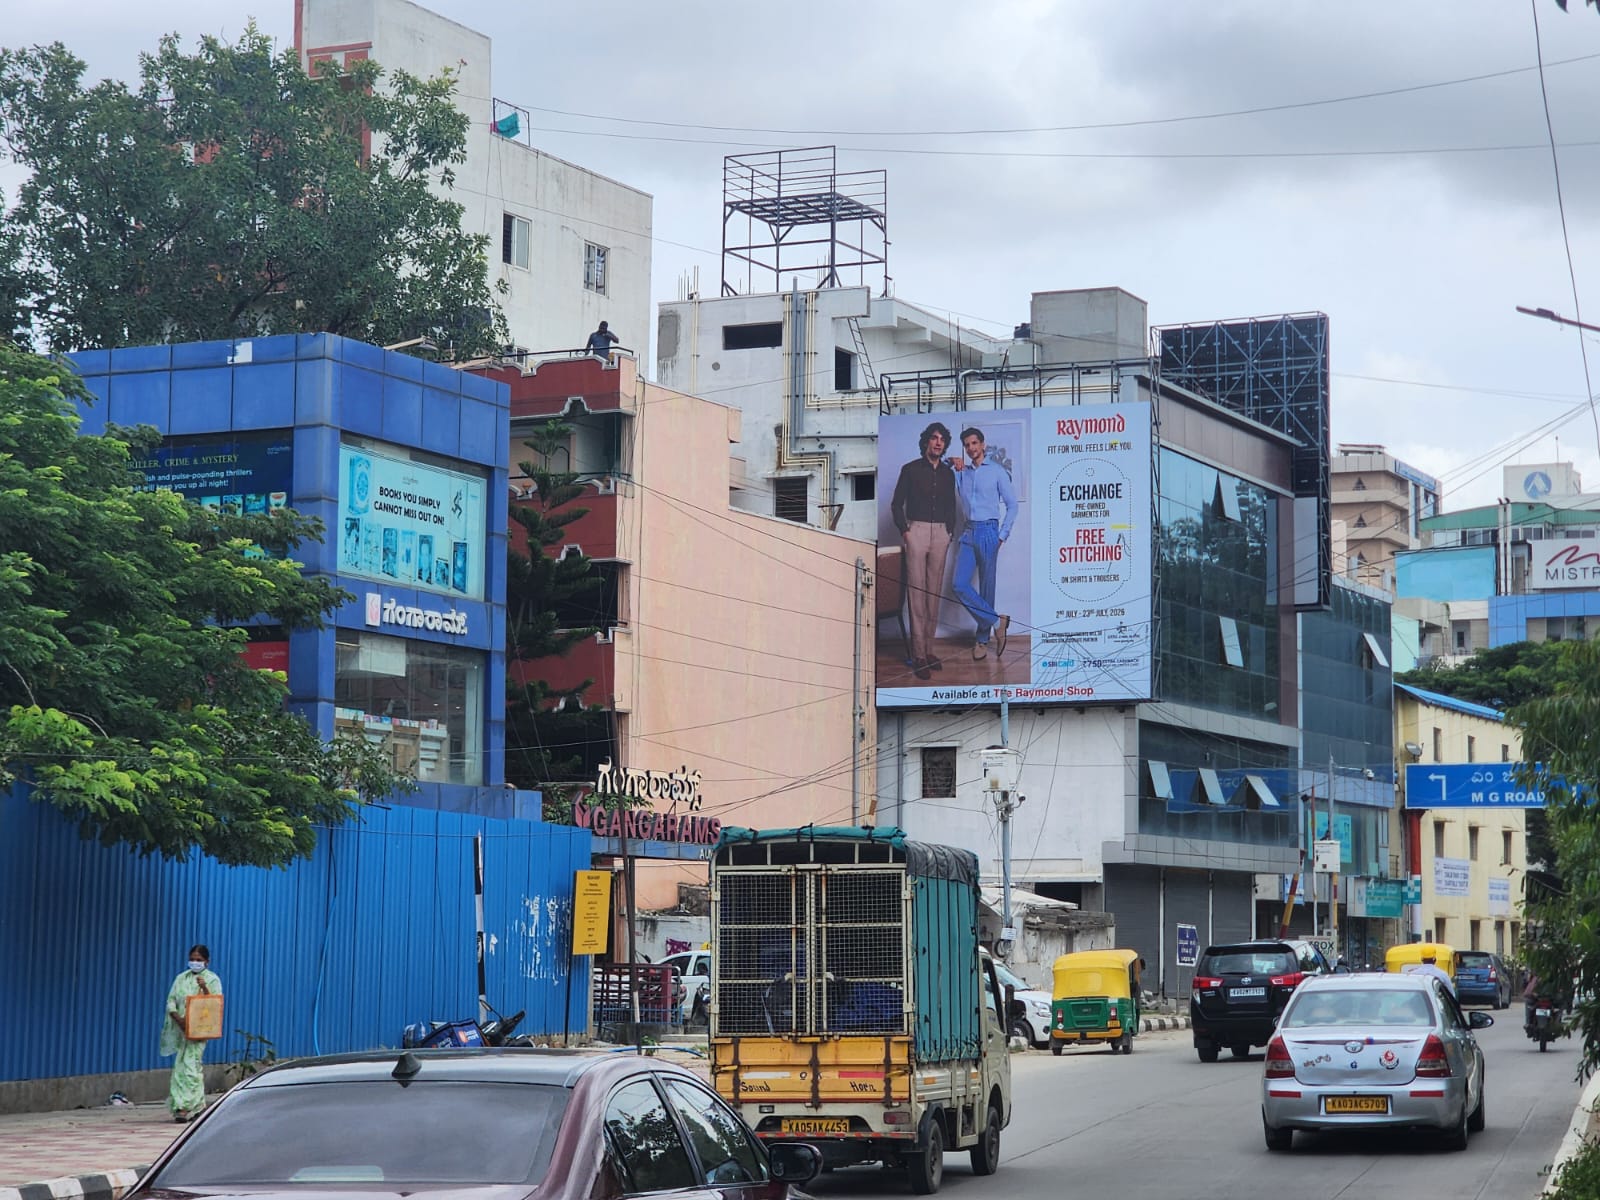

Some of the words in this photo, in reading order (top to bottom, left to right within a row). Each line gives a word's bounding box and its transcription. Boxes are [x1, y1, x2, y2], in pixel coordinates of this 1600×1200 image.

[1057, 413, 1125, 440] Raymond
[1047, 445, 1057, 455] FIT
[1058, 445, 1070, 454] FOR
[1085, 443, 1104, 453] FEELS
[1105, 442, 1118, 452] LIKE
[164, 458, 190, 468] CRIME
[193, 457, 199, 466] &
[201, 454, 239, 465] MYSTERY
[157, 473, 170, 482] and
[171, 471, 225, 482] pulse-pounding
[225, 469, 253, 477] thrillers
[174, 482, 187, 490] you
[188, 481, 198, 489] up
[198, 479, 208, 487] all
[208, 479, 229, 489] night!
[379, 486, 402, 501] BOOKS
[403, 492, 417, 504] YOU
[418, 494, 441, 510] SIMPLY
[1059, 483, 1123, 501] EXCHANGE
[1075, 502, 1106, 510] PRE-OWNED
[373, 500, 402, 516] CANNOT
[403, 507, 417, 519] MISS
[418, 511, 431, 522] OUT
[433, 514, 445, 526] ON!
[1071, 511, 1099, 519] GARMENTS
[1099, 510, 1110, 518] FOR
[1075, 528, 1105, 545] FREE
[1059, 545, 1122, 563] STITCHING
[1061, 576, 1069, 584] ON
[1069, 575, 1088, 584] SHIRTS
[1093, 574, 1120, 582] TROUSERS
[1065, 609, 1078, 618] JULY
[931, 689, 978, 700] Available
[980, 689, 990, 699] at
[1015, 687, 1063, 699] Raymond
[1066, 686, 1094, 697] Shop
[1471, 792, 1484, 803] M
[1488, 792, 1500, 803] G
[1504, 792, 1546, 803] ROAD
[593, 806, 721, 845] GANGARAMS
[741, 1081, 771, 1092] Sound
